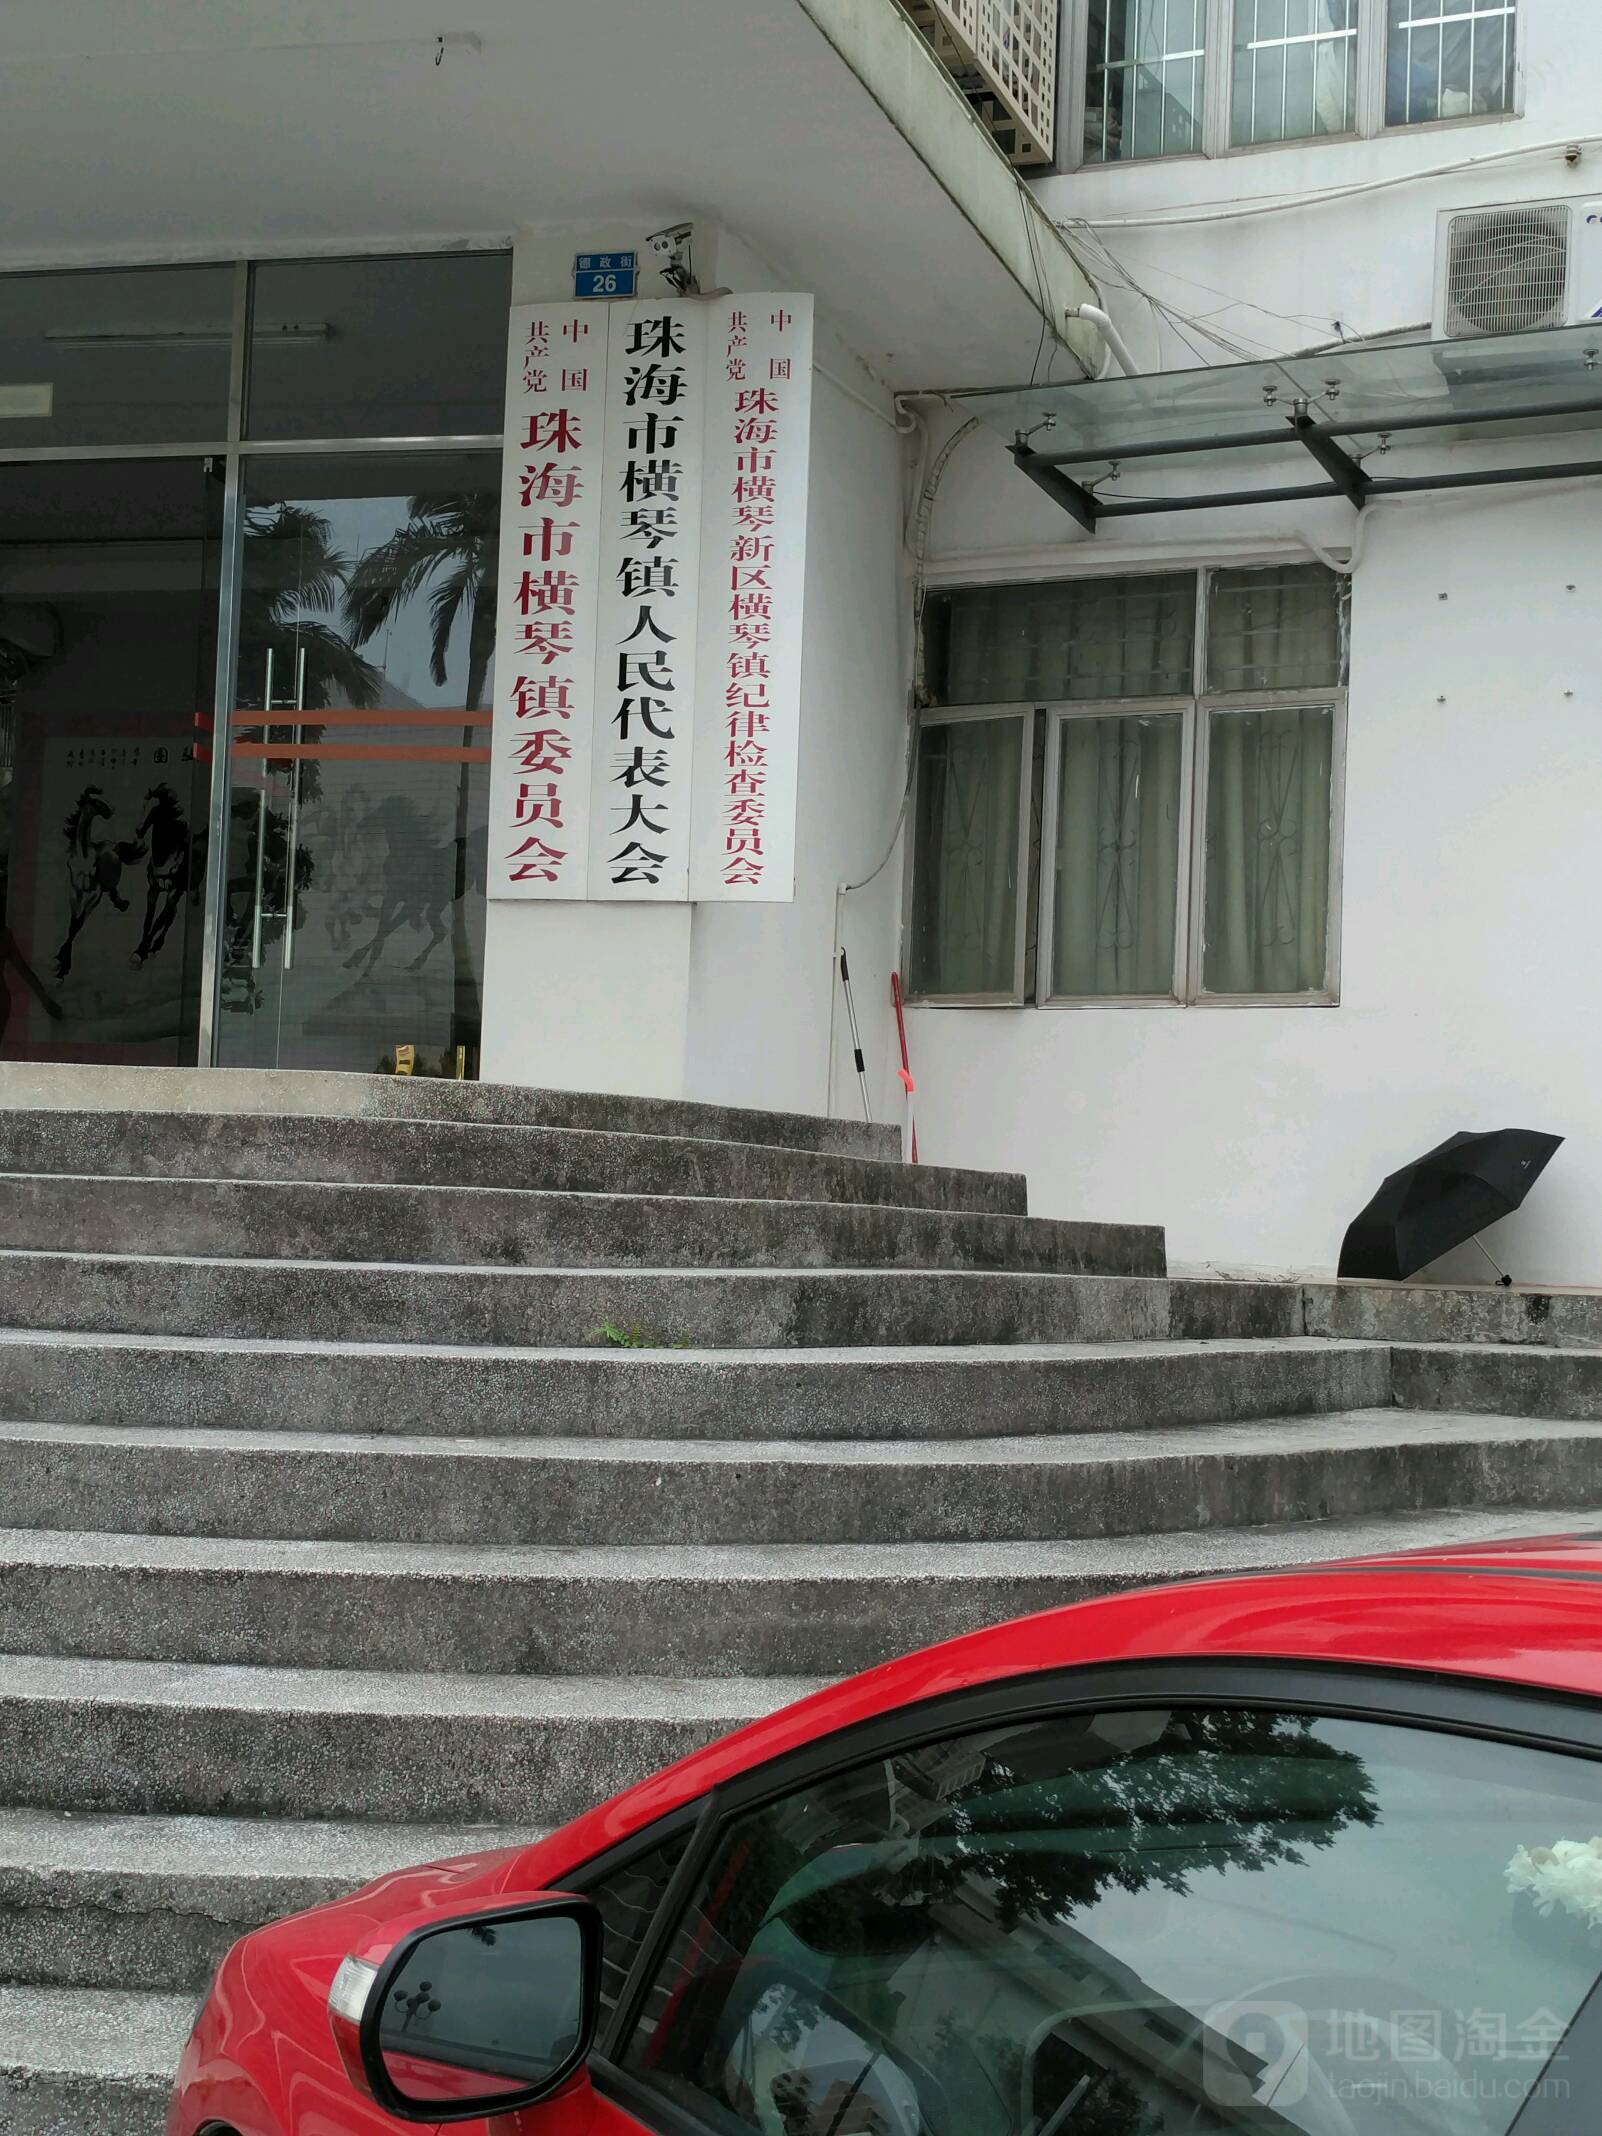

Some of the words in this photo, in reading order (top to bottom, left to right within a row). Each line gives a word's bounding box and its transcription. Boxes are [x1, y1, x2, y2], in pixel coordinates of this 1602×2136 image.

[592, 274, 617, 293] 26
[522, 320, 551, 394] 共产党
[561, 319, 589, 392] 中国
[725, 311, 749, 382] 共产党
[768, 309, 793, 382] 中国
[607, 315, 689, 885] 珠海市横琴镇人民代表大会
[719, 387, 780, 886] 珠海市横琴新区横琴镇纪律检查委员会
[503, 408, 585, 882] 珠海市横琴镇委员会
